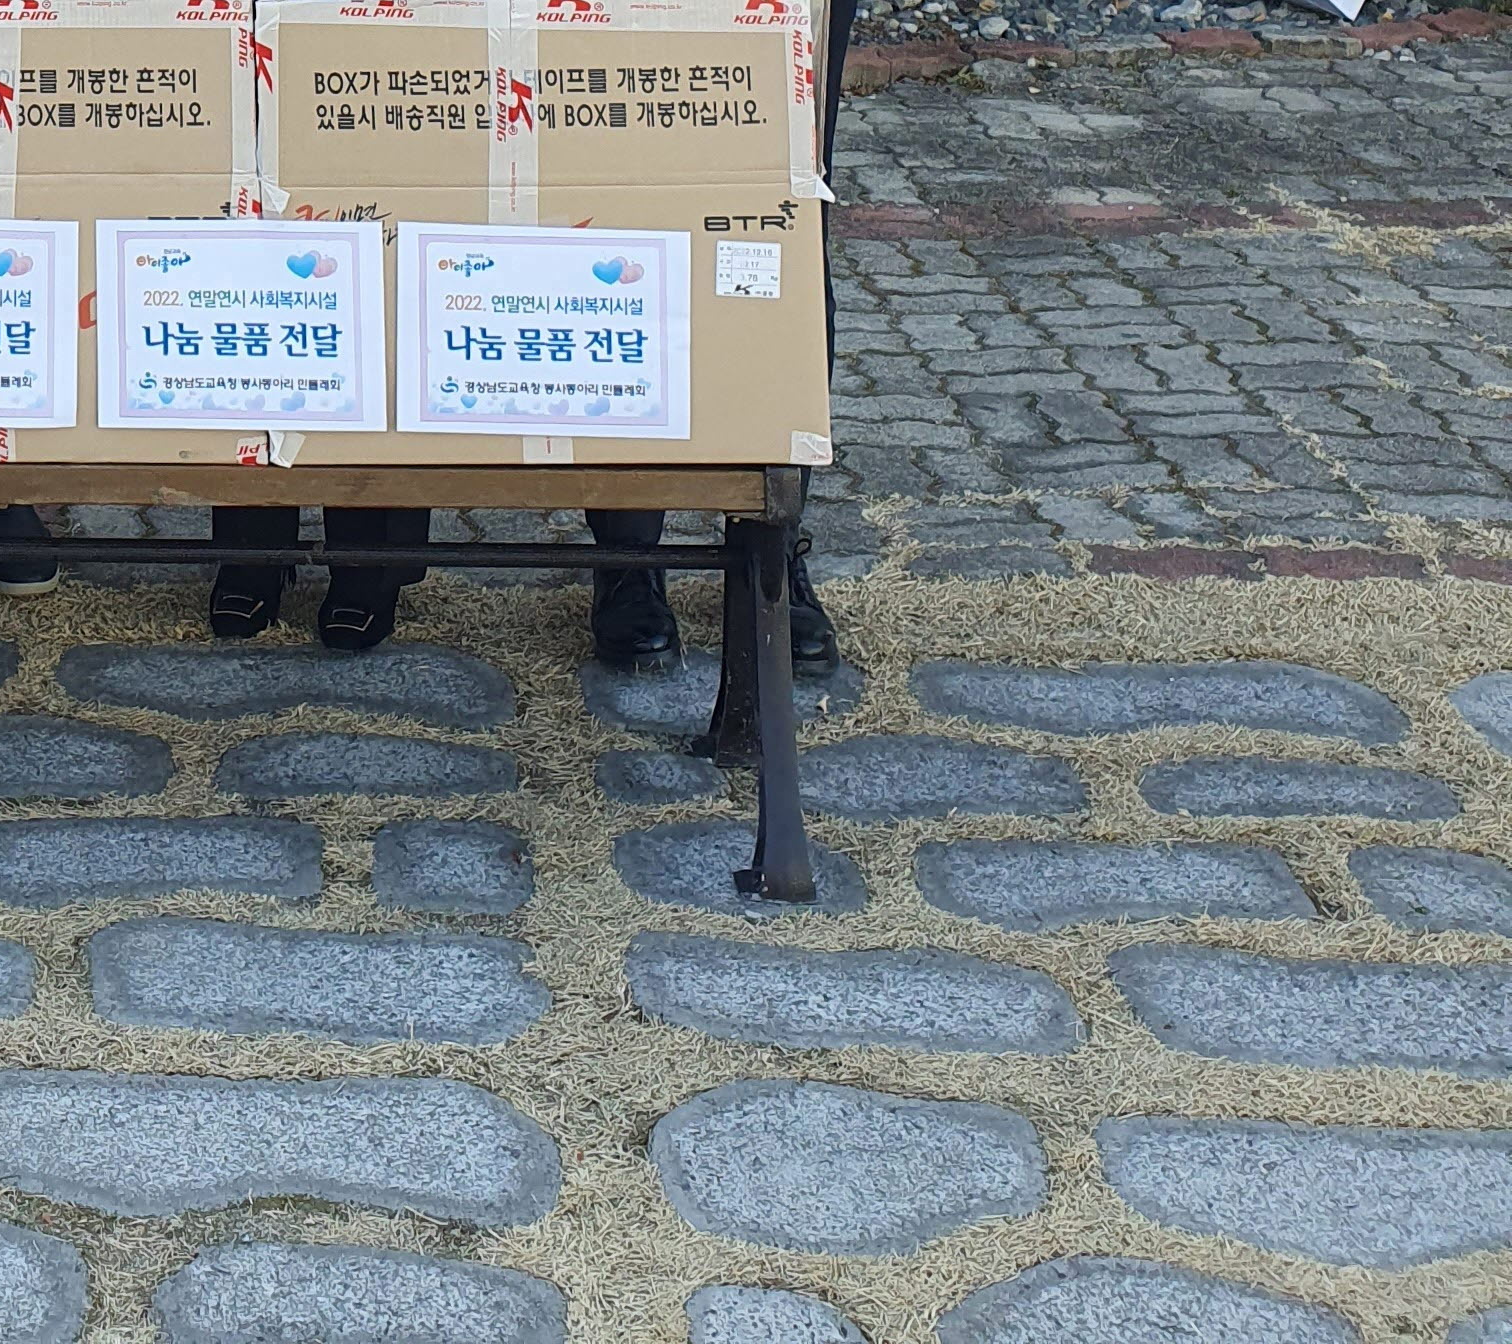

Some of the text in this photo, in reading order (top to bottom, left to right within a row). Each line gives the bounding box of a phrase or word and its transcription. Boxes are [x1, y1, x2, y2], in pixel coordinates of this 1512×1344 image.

[176, 11, 249, 21] KOLPING
[340, 7, 414, 18] KOLPING
[536, 13, 610, 23] KOLPING
[734, 14, 809, 26] KOLPING
[792, 30, 806, 104] KOLPING
[67, 68, 129, 92] 개봉한
[137, 68, 197, 92] 흔적이
[314, 71, 380, 96] BOX가
[617, 67, 680, 93] 개봉한
[689, 66, 753, 93] 흔적이
[17, 104, 77, 127] BOX를
[85, 103, 211, 128] 개봉하십시오.
[317, 104, 377, 131] 있을시
[386, 103, 465, 130] 배송직원
[565, 102, 627, 127] BOX를
[636, 100, 768, 127] 개봉하십시오.
[497, 67, 507, 142] KOLPING
[704, 216, 786, 231] BTR
[143, 289, 337, 310] 2022. 연말연시 사회복지시설
[445, 295, 643, 316] 2022. 연말연시 사회복지시설
[142, 321, 342, 359] 나눔 물품 전달
[444, 326, 648, 364] 나눔 물품 전달
